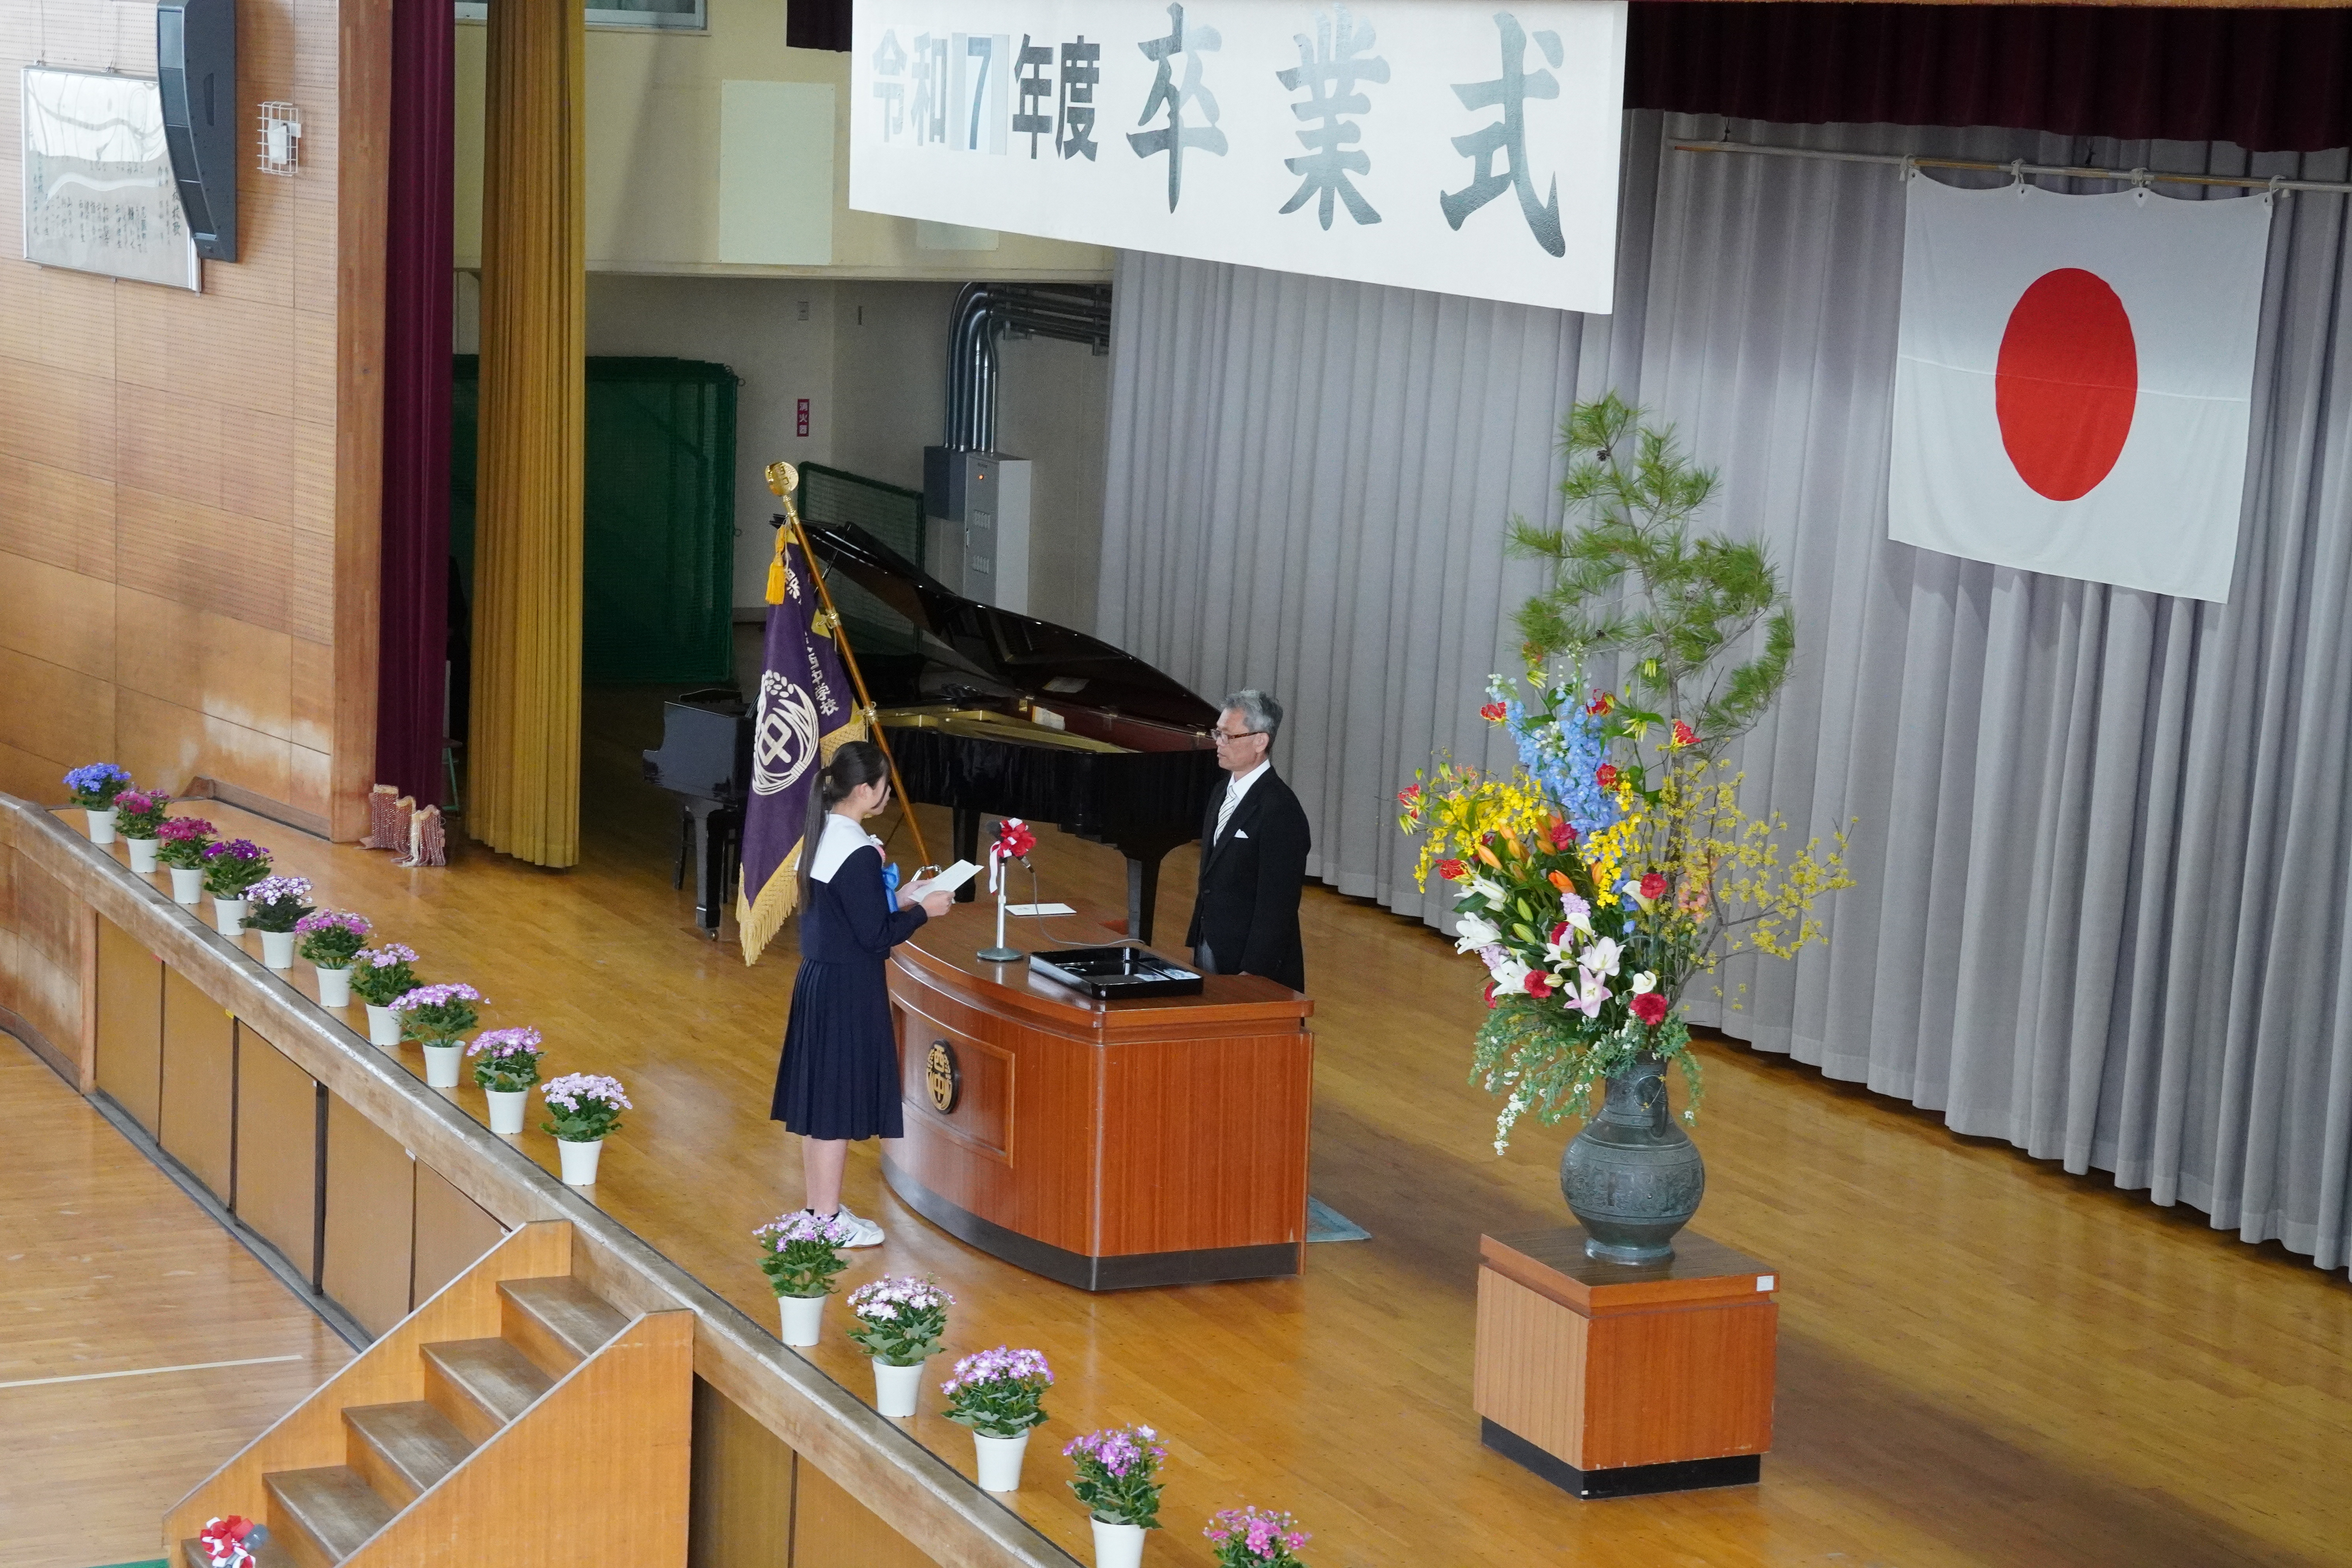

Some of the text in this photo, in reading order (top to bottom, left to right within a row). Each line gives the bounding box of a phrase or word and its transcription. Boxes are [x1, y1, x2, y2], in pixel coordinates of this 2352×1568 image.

[871, 2, 1566, 258] 令和7年度 卒業式
[808, 647, 839, 716] 西中学校
